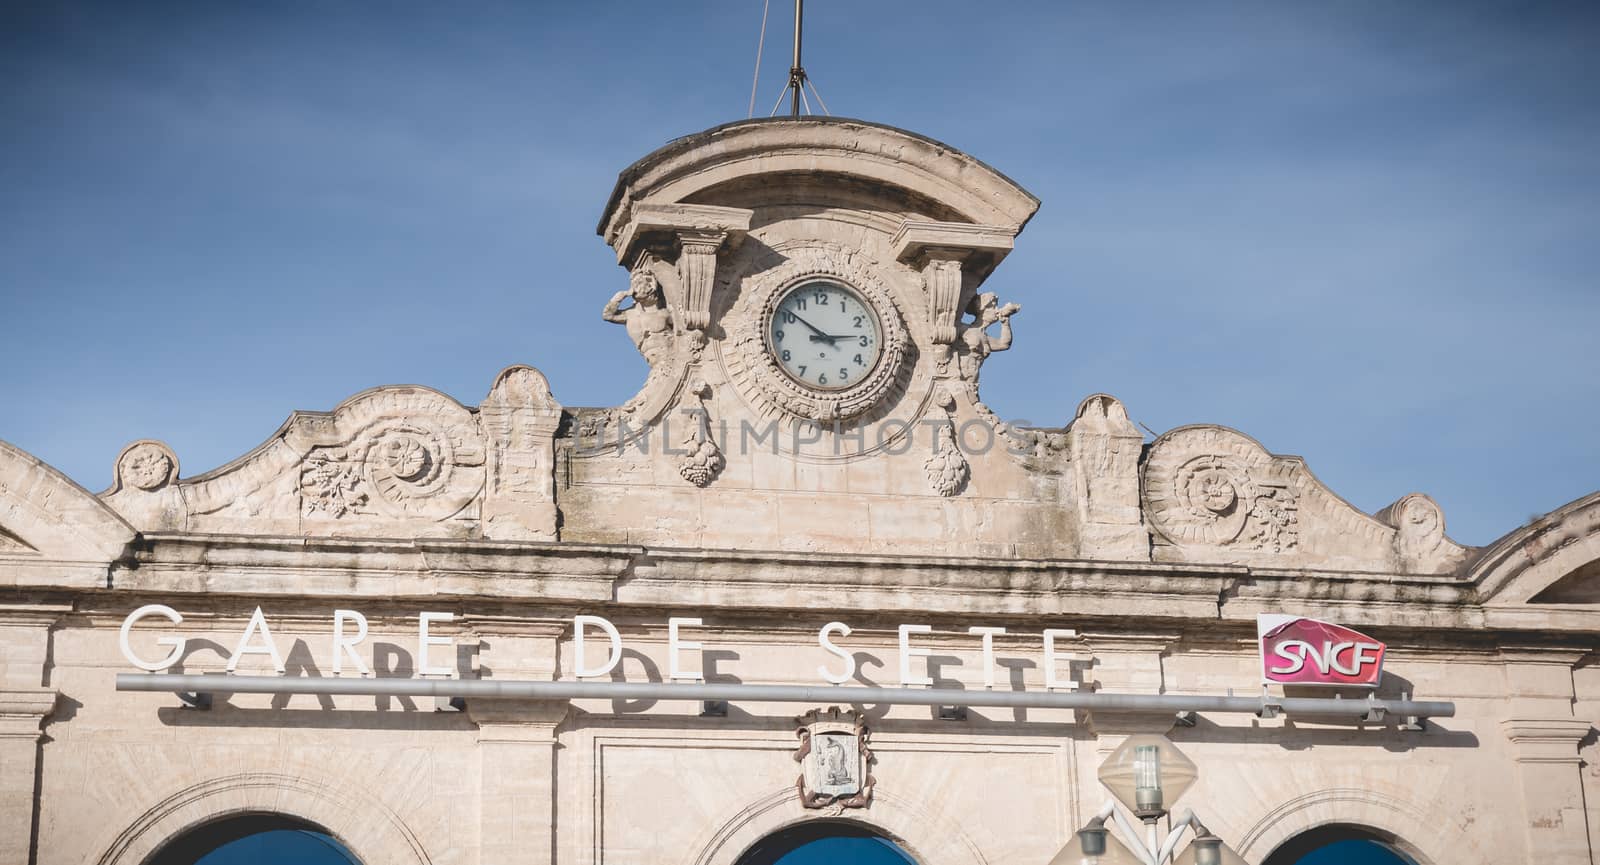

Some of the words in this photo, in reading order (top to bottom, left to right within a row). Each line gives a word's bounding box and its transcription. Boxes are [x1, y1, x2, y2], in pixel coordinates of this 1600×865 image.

[797, 299, 807, 311] 11
[814, 293, 828, 305] 12
[840, 301, 846, 313] 1
[782, 311, 796, 324] 10
[853, 316, 862, 328] 2
[775, 330, 785, 342] 9
[859, 335, 868, 347] 3
[782, 350, 791, 362] 8
[853, 354, 863, 365] 4
[798, 365, 807, 377] 7
[839, 368, 848, 379] 5
[818, 373, 827, 385] 6
[119, 604, 454, 675] GARE
[574, 615, 703, 680] DE
[817, 621, 1079, 689] SETE
[1271, 640, 1380, 675] SNCF
